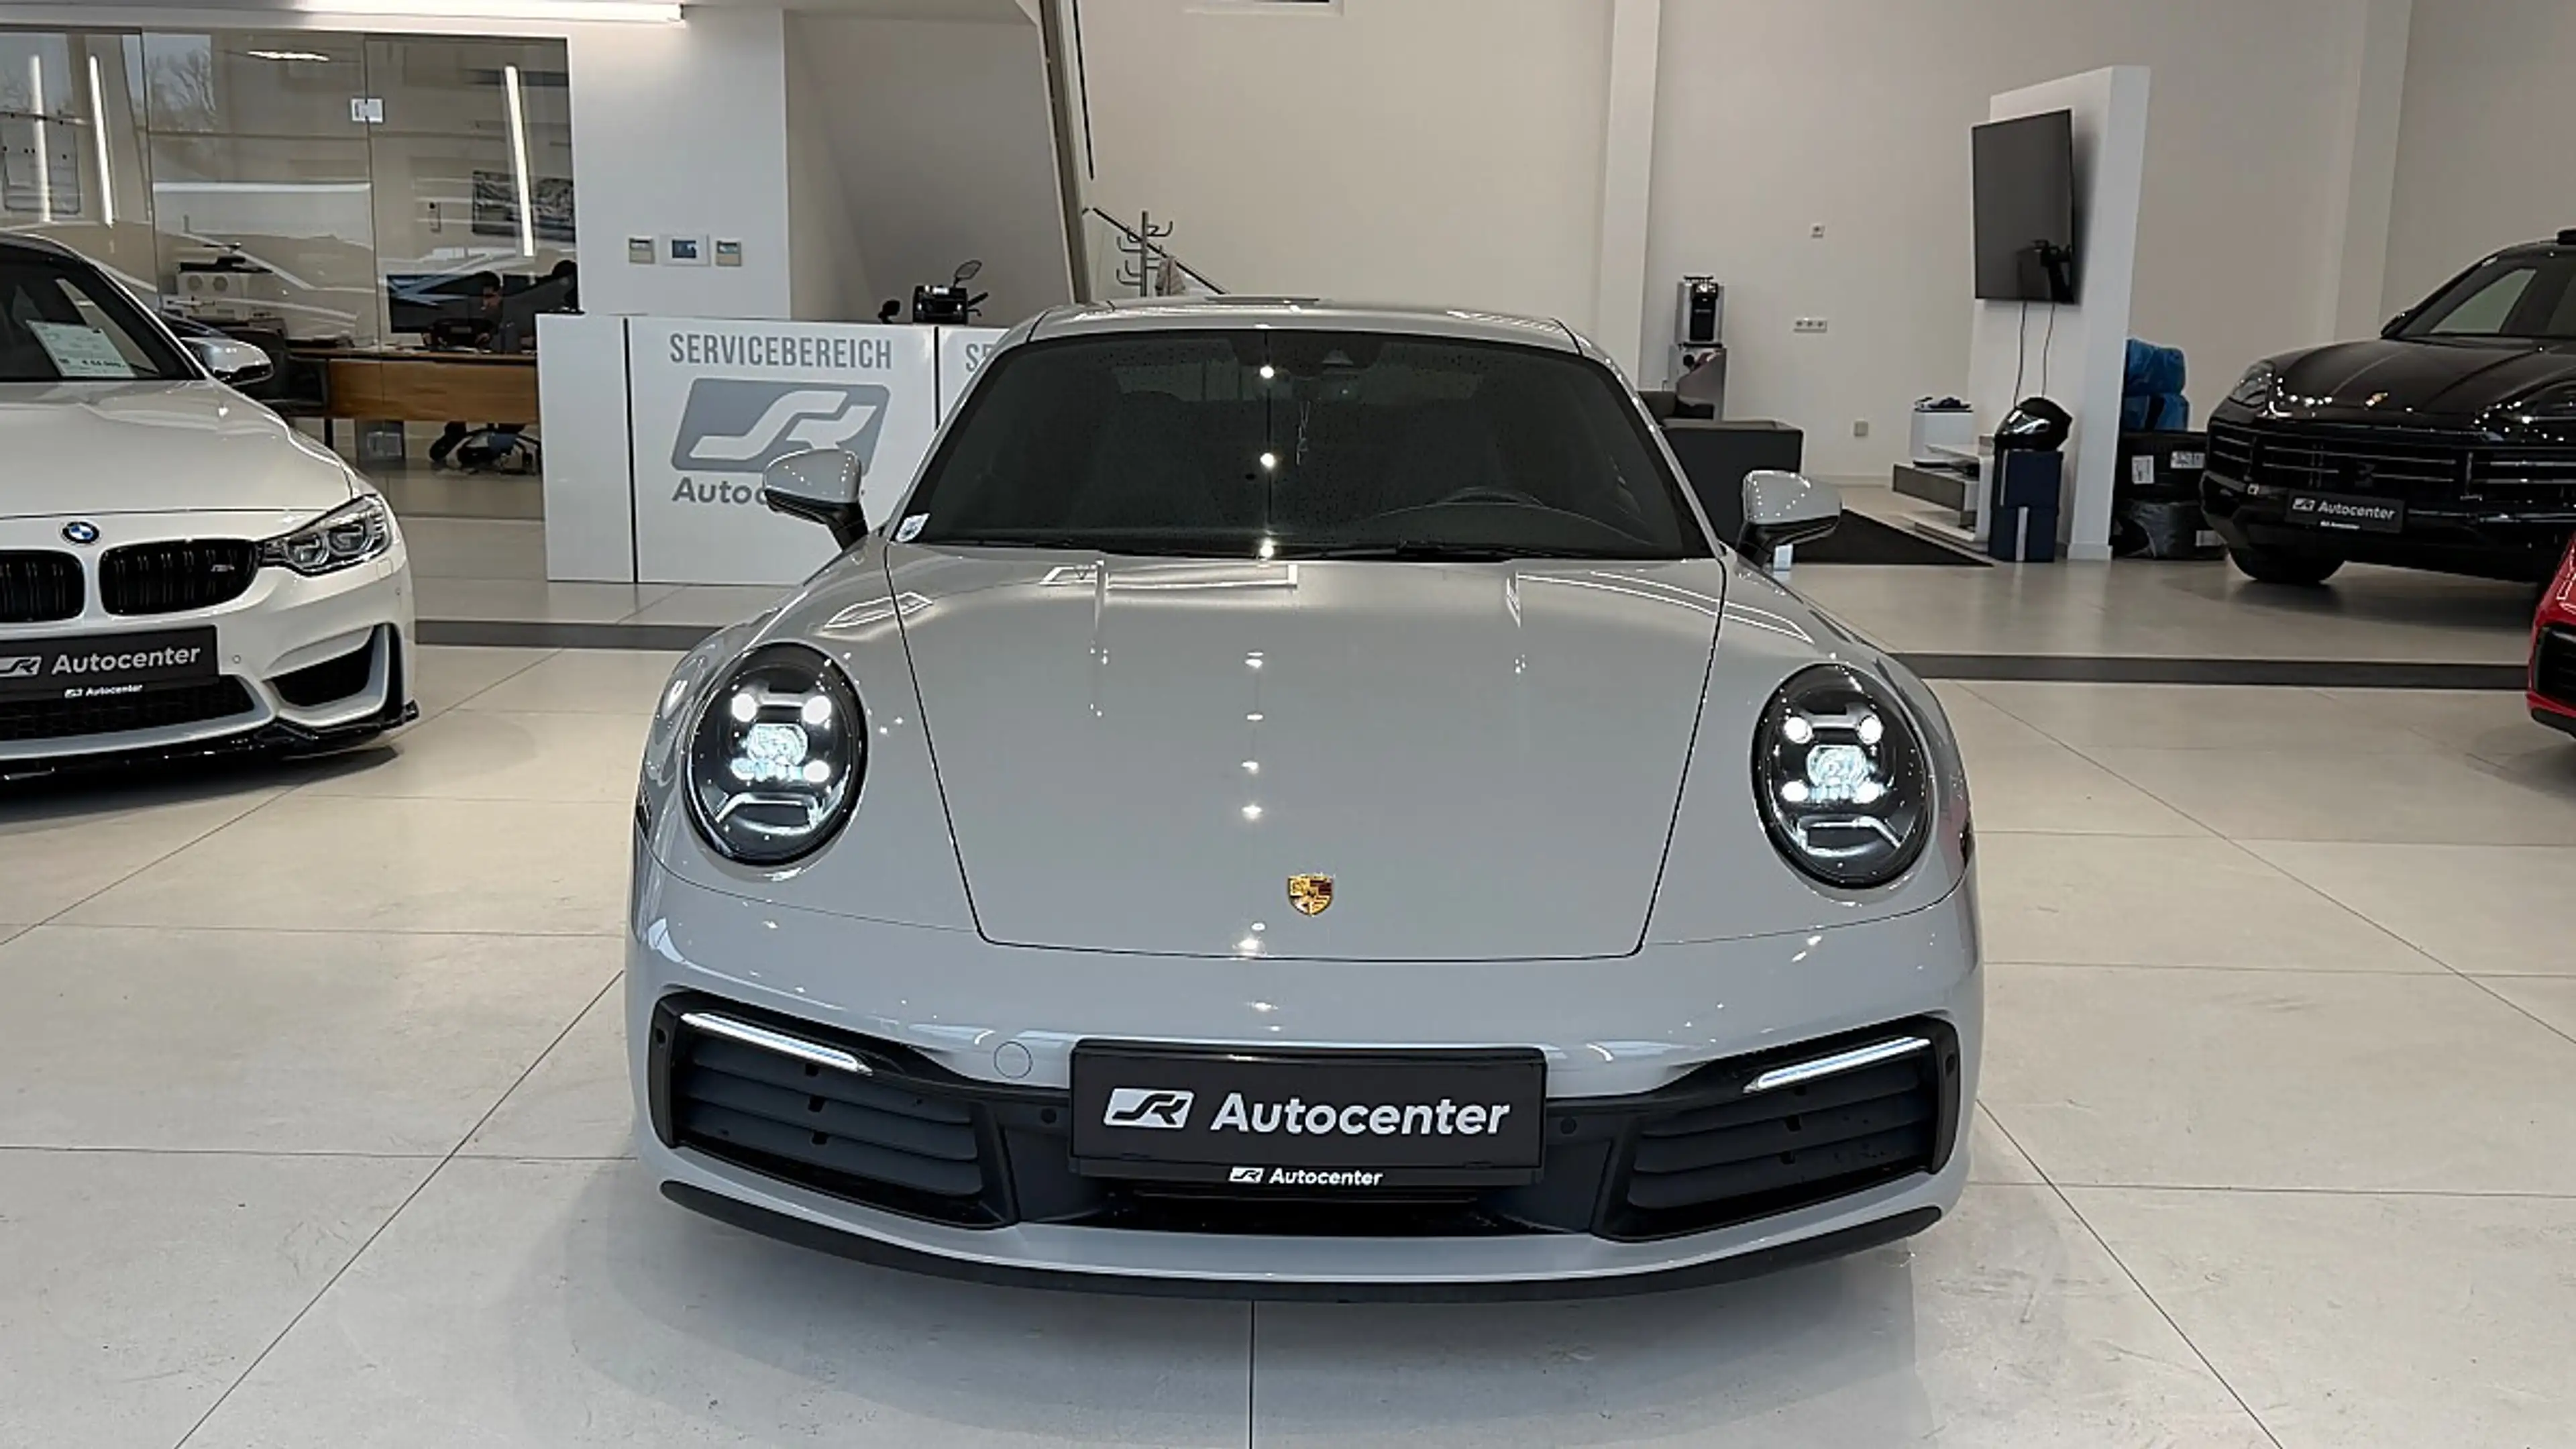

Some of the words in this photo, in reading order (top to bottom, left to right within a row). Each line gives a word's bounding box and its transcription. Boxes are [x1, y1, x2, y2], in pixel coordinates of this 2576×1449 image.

[670, 333, 891, 369] SERVICEBEREICH
[2318, 501, 2395, 519] Autocenter
[52, 647, 200, 675] Autocenter
[1211, 1093, 1510, 1134] Autocenter
[1269, 1167, 1383, 1186] Autocenter
